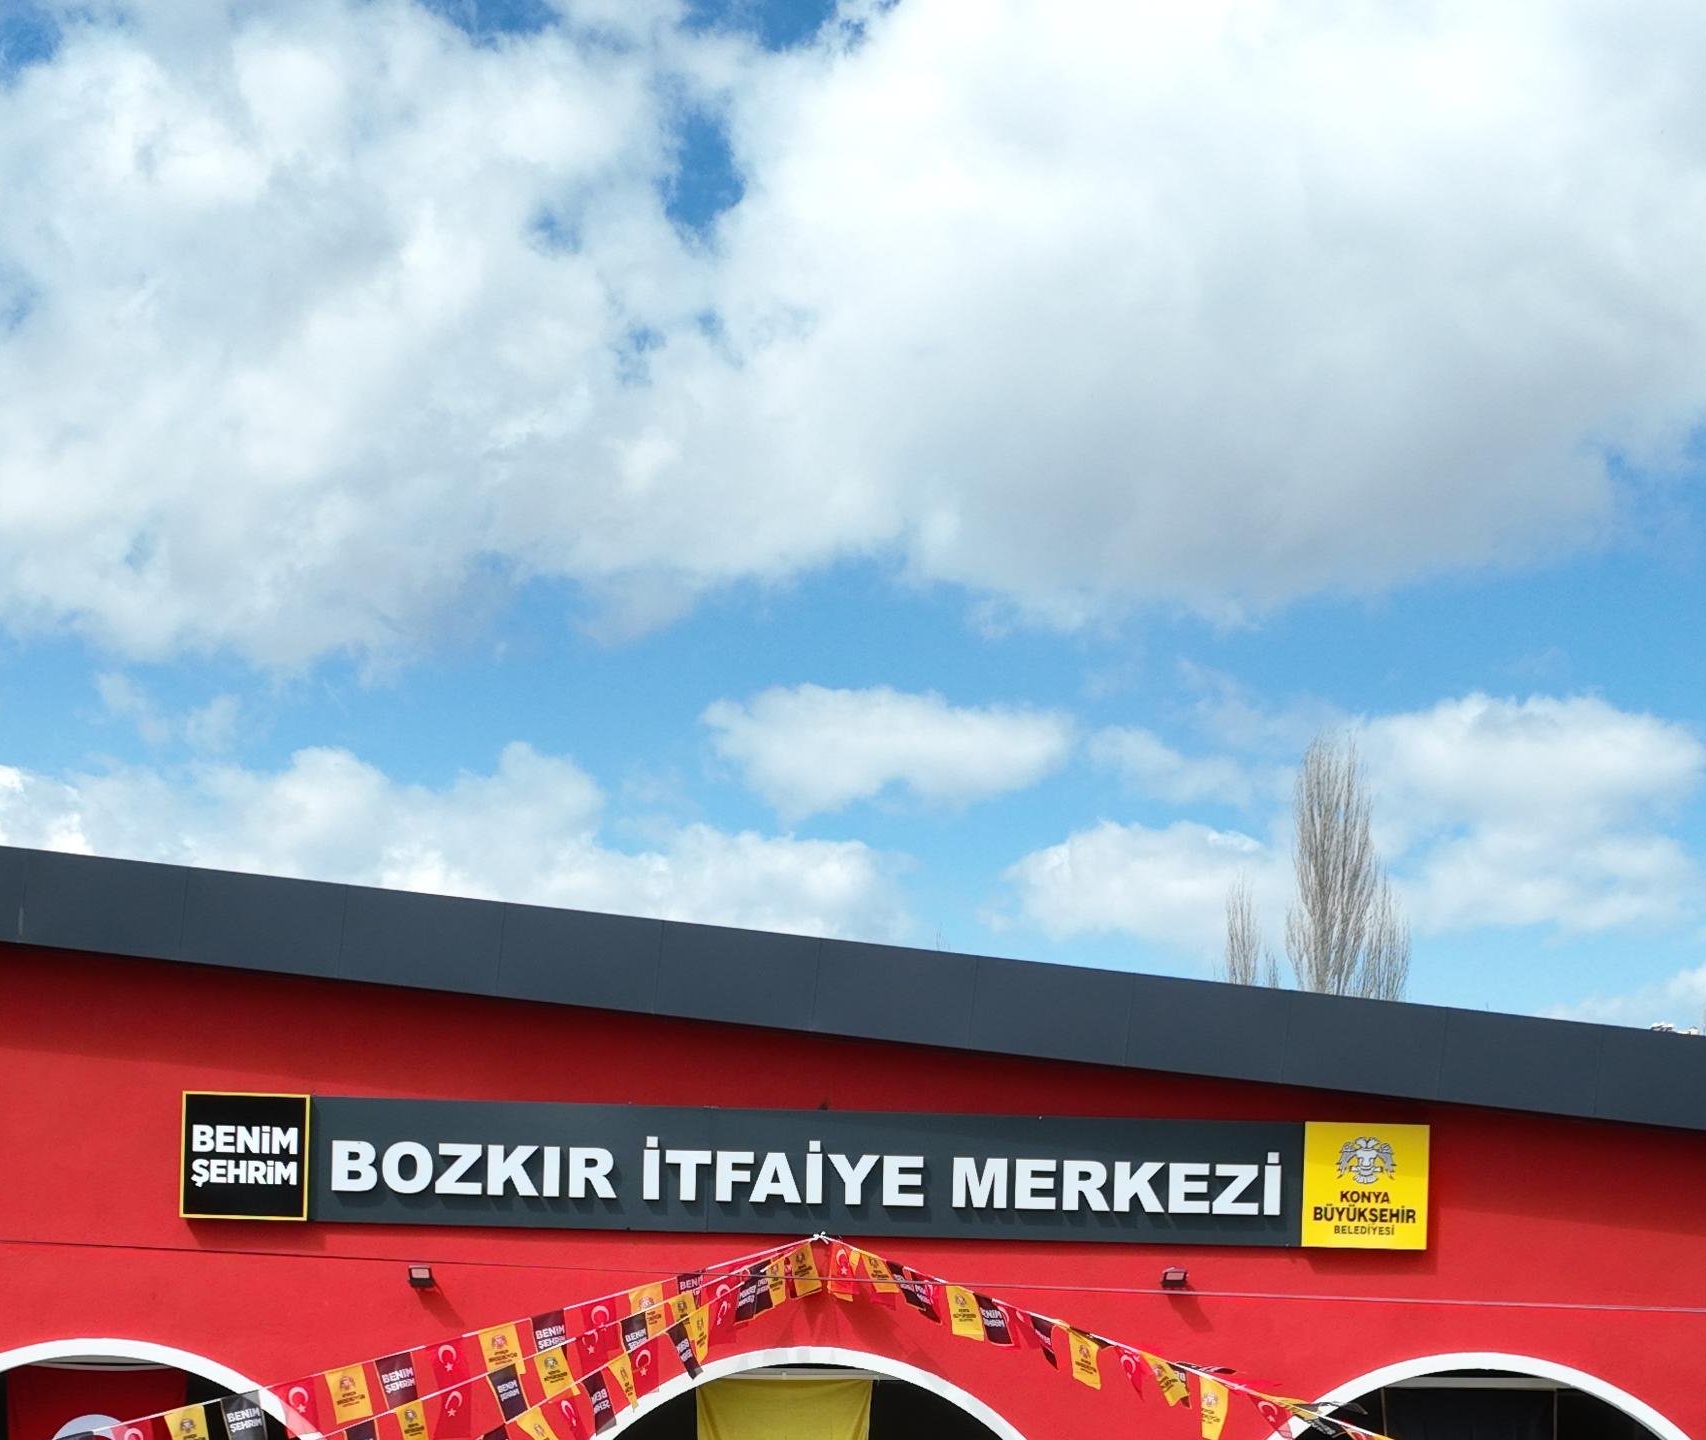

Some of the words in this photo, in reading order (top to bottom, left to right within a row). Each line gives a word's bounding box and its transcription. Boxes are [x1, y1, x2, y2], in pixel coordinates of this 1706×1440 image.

[192, 1124, 299, 1155] BENİM
[190, 1158, 298, 1188] ŞEHRİM
[331, 1140, 617, 1198] BOZKIR
[643, 1136, 924, 1207] İTFAİYE
[952, 1151, 1282, 1216] MERKEZİ
[1340, 1190, 1391, 1204] KONYA
[1313, 1203, 1416, 1224] BÜYÜKŞEHİR
[1334, 1224, 1395, 1235] BELEDİYESİ
[381, 1367, 414, 1385] BENİM
[226, 1407, 261, 1423] BENİM
